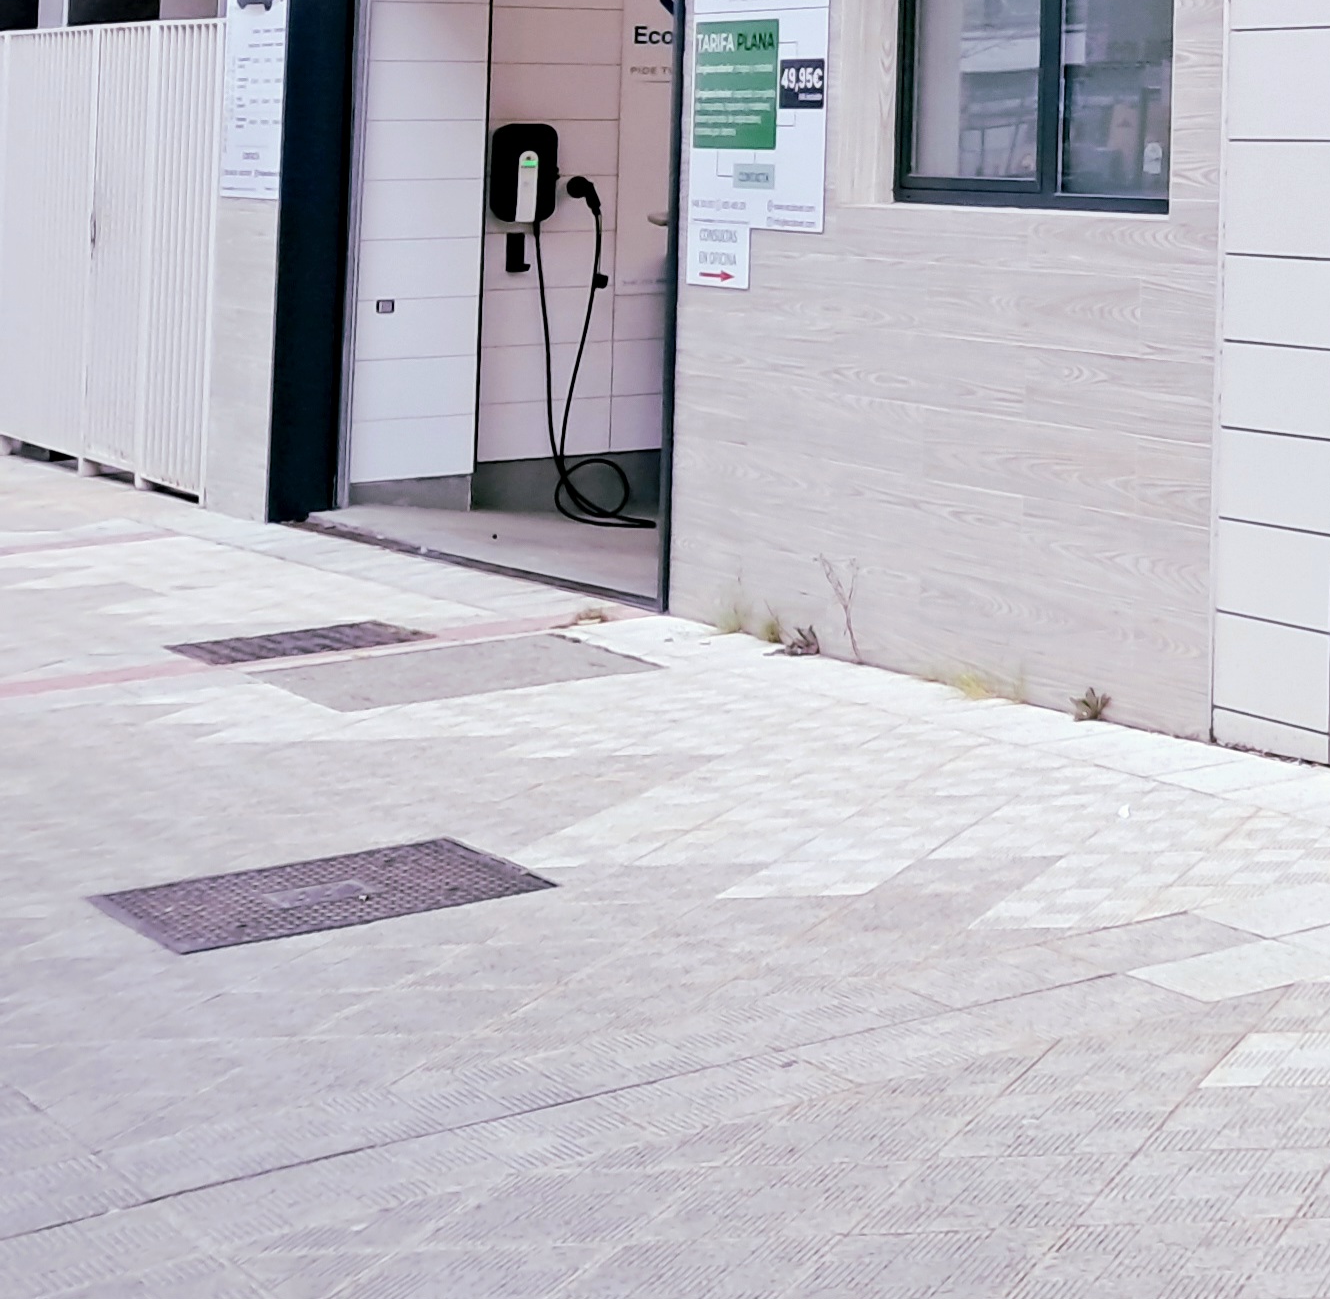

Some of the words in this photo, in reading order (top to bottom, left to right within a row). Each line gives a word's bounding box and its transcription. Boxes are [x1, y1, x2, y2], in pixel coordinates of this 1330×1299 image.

[697, 33, 735, 53] TARIFA
[736, 32, 775, 51] PLANA
[780, 67, 823, 92] 49,95€
